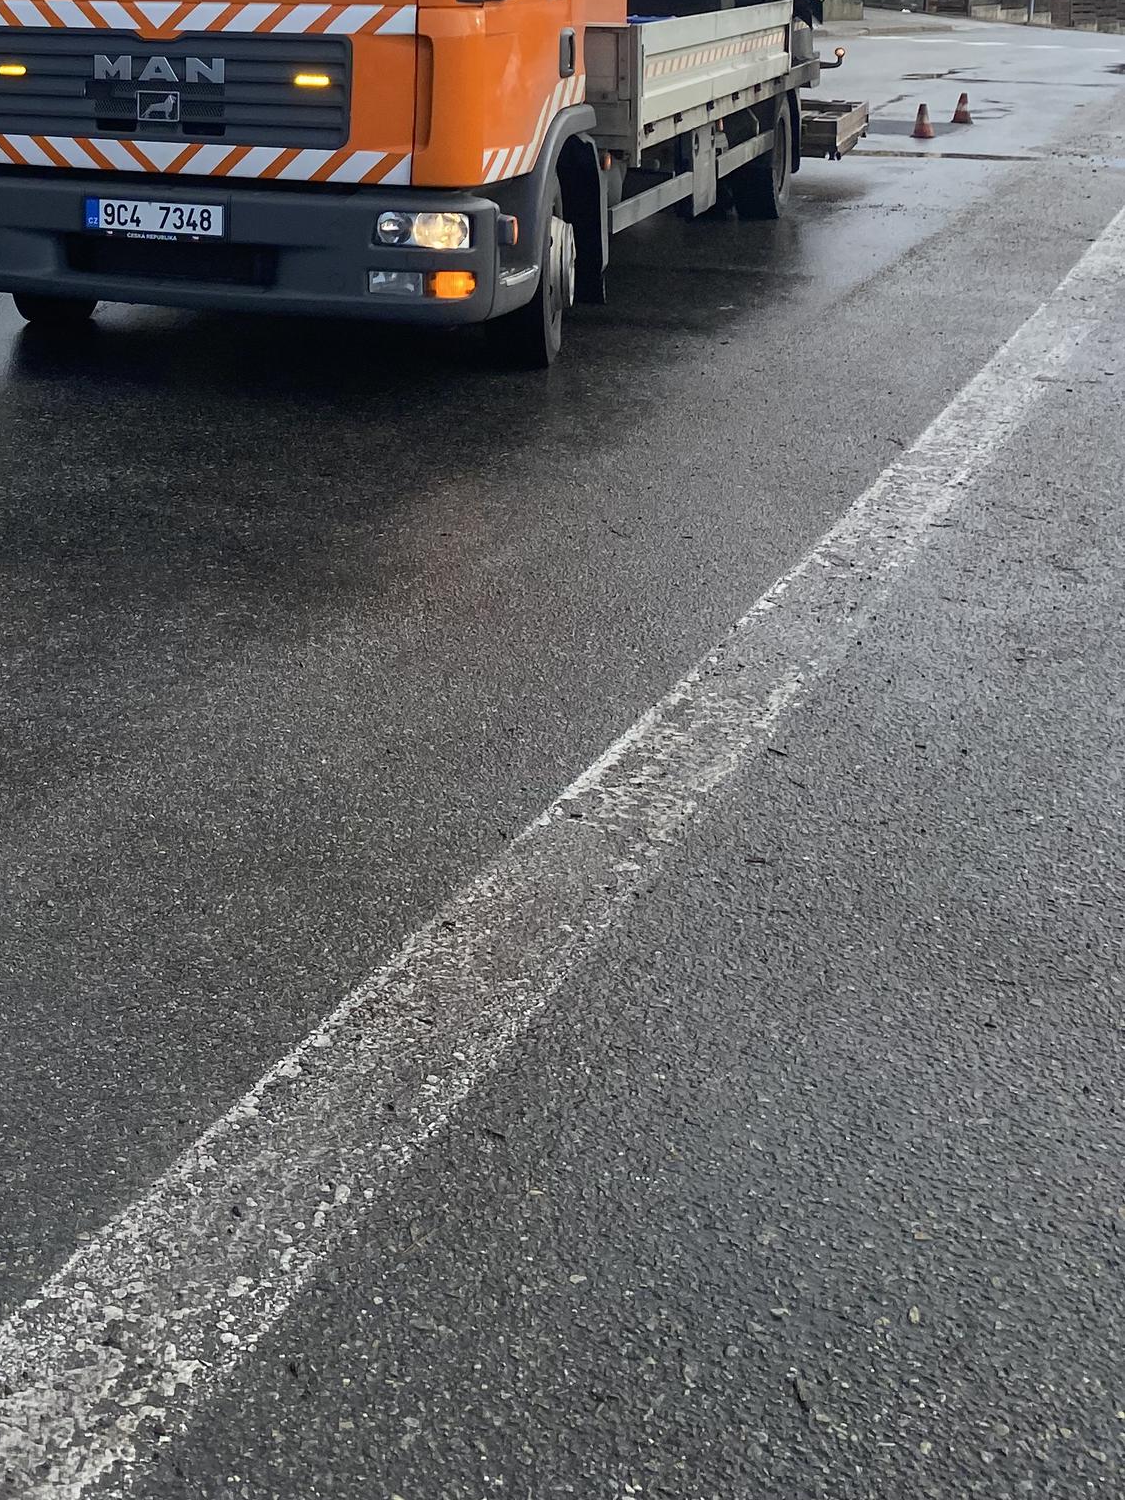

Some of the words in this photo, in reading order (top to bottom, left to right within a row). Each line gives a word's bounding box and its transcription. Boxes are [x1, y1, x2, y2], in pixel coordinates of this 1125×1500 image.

[94, 54, 225, 84] MAN
[88, 216, 99, 225] CZ
[103, 203, 142, 228] 9C4
[158, 205, 212, 232] 7348
[146, 233, 177, 242] REPUBLIKA
